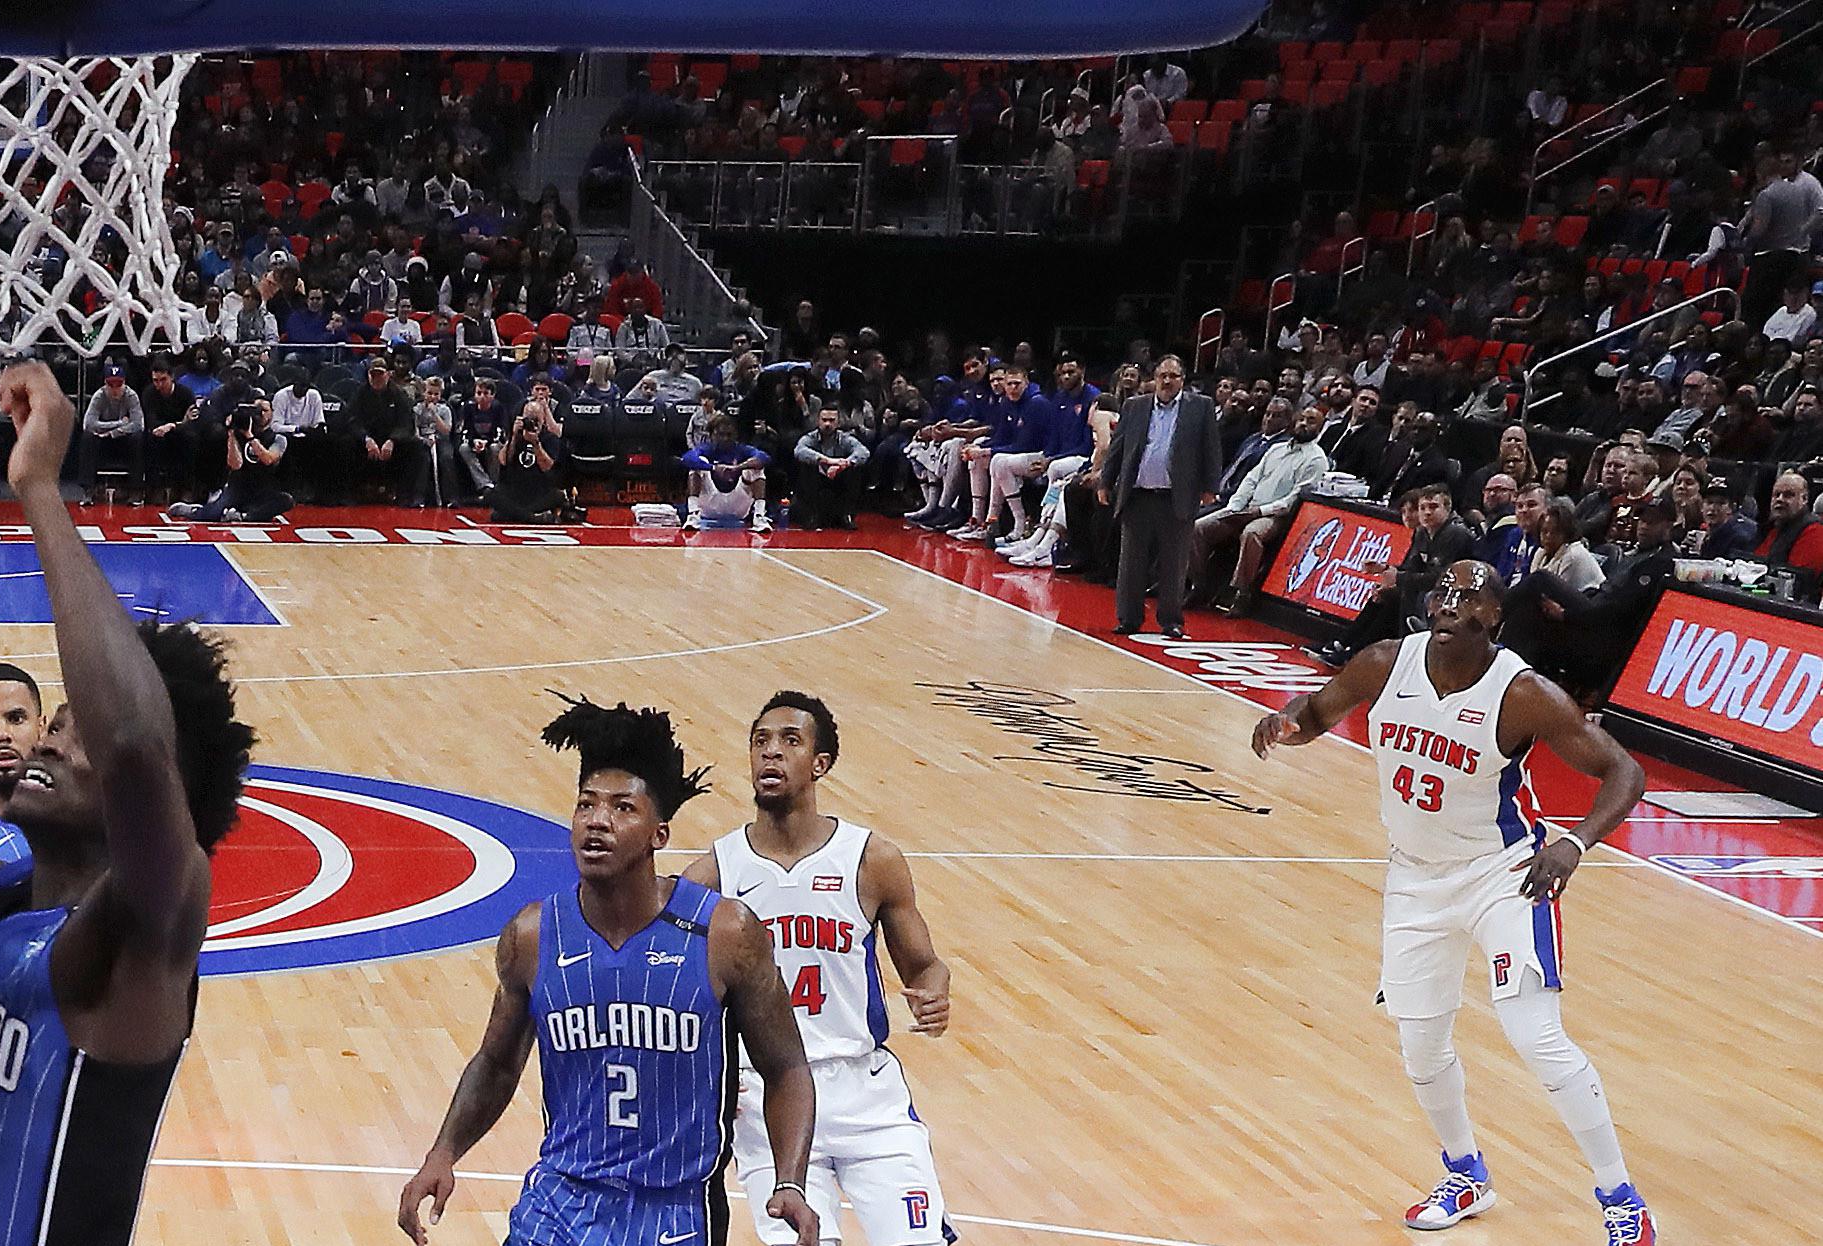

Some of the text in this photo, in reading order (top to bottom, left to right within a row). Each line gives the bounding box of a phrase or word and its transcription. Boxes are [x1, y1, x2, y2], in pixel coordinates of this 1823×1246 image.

[1340, 526, 1392, 571] Little
[1314, 558, 1376, 611] Caesar
[1128, 633, 1334, 692] Jeep
[1647, 618, 1823, 747] WORLD
[1379, 722, 1481, 775] PISTONS
[1392, 764, 1445, 812] 43
[645, 951, 686, 967] Disney
[762, 914, 854, 954] STONS
[790, 964, 827, 1016] 4
[546, 1000, 701, 1053] ORLANDO
[606, 1061, 639, 1129] 2
